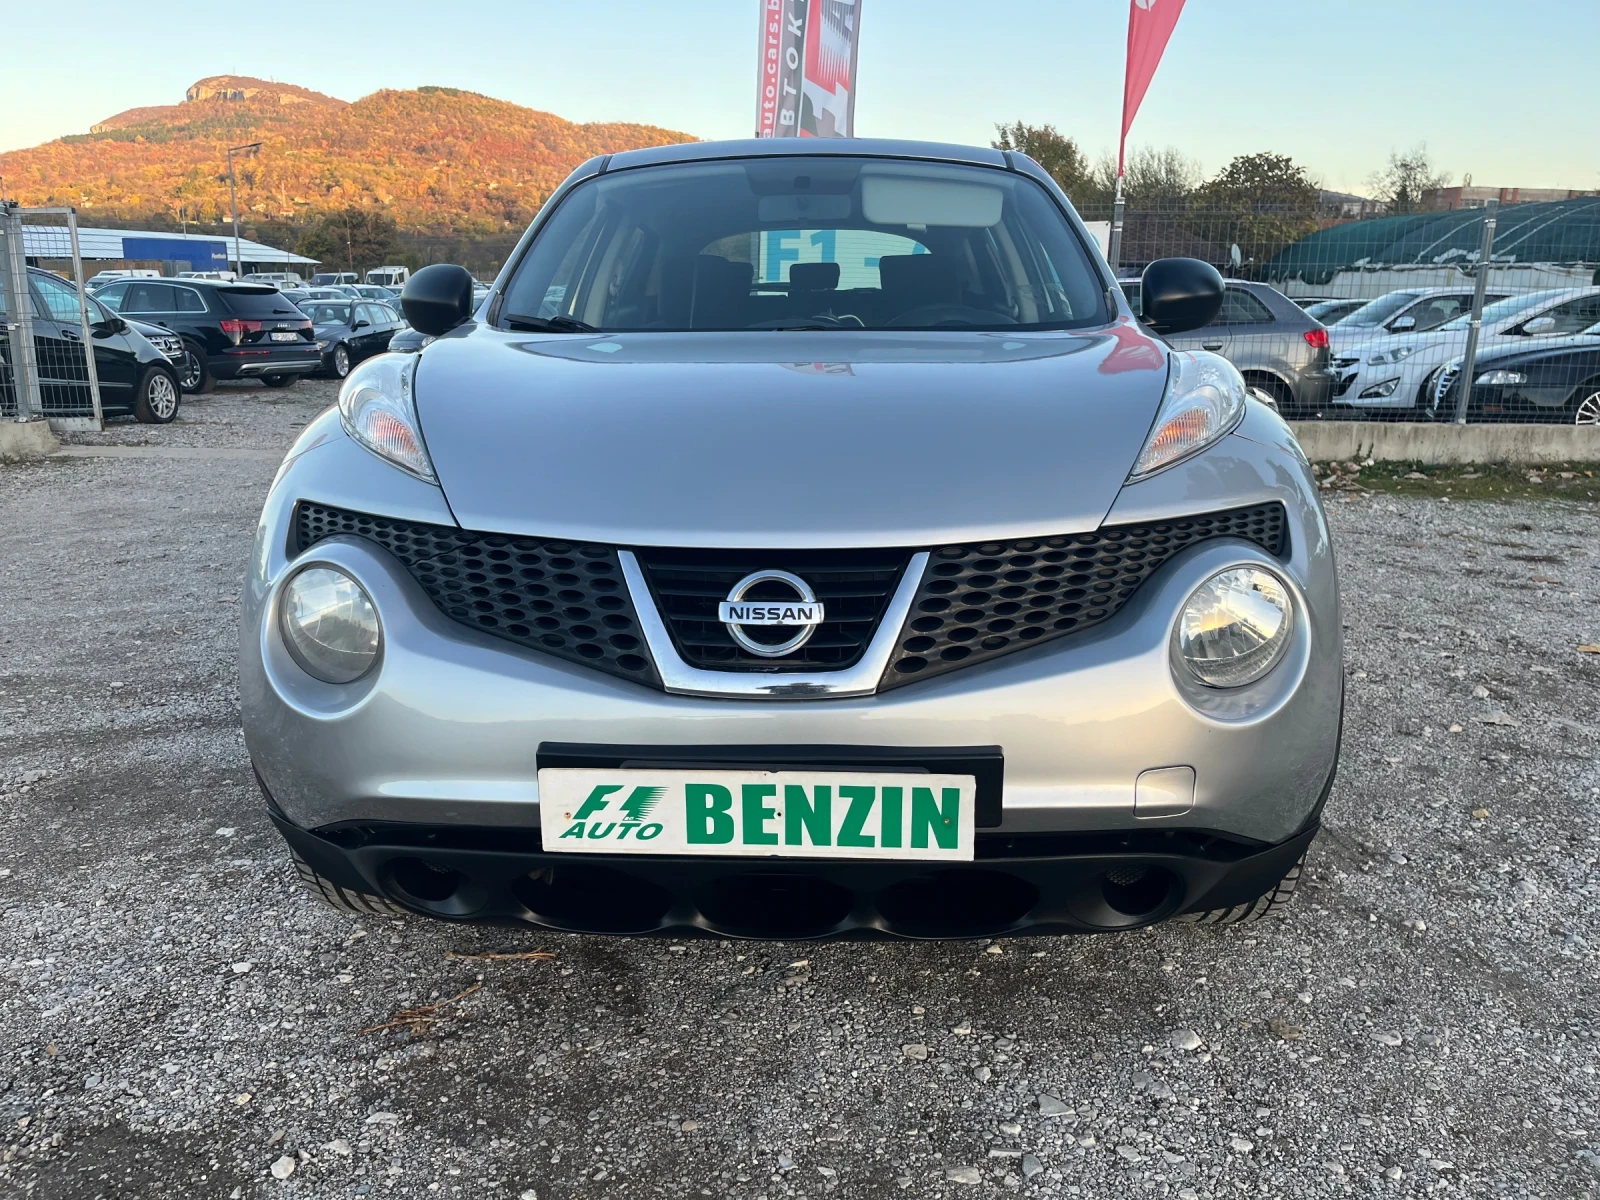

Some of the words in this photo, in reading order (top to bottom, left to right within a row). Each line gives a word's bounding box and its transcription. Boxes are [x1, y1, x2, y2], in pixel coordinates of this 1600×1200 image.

[729, 606, 813, 621] NISSAN
[572, 785, 669, 822] F1
[685, 783, 960, 849] BENZIN
[559, 822, 664, 841] AUTO
